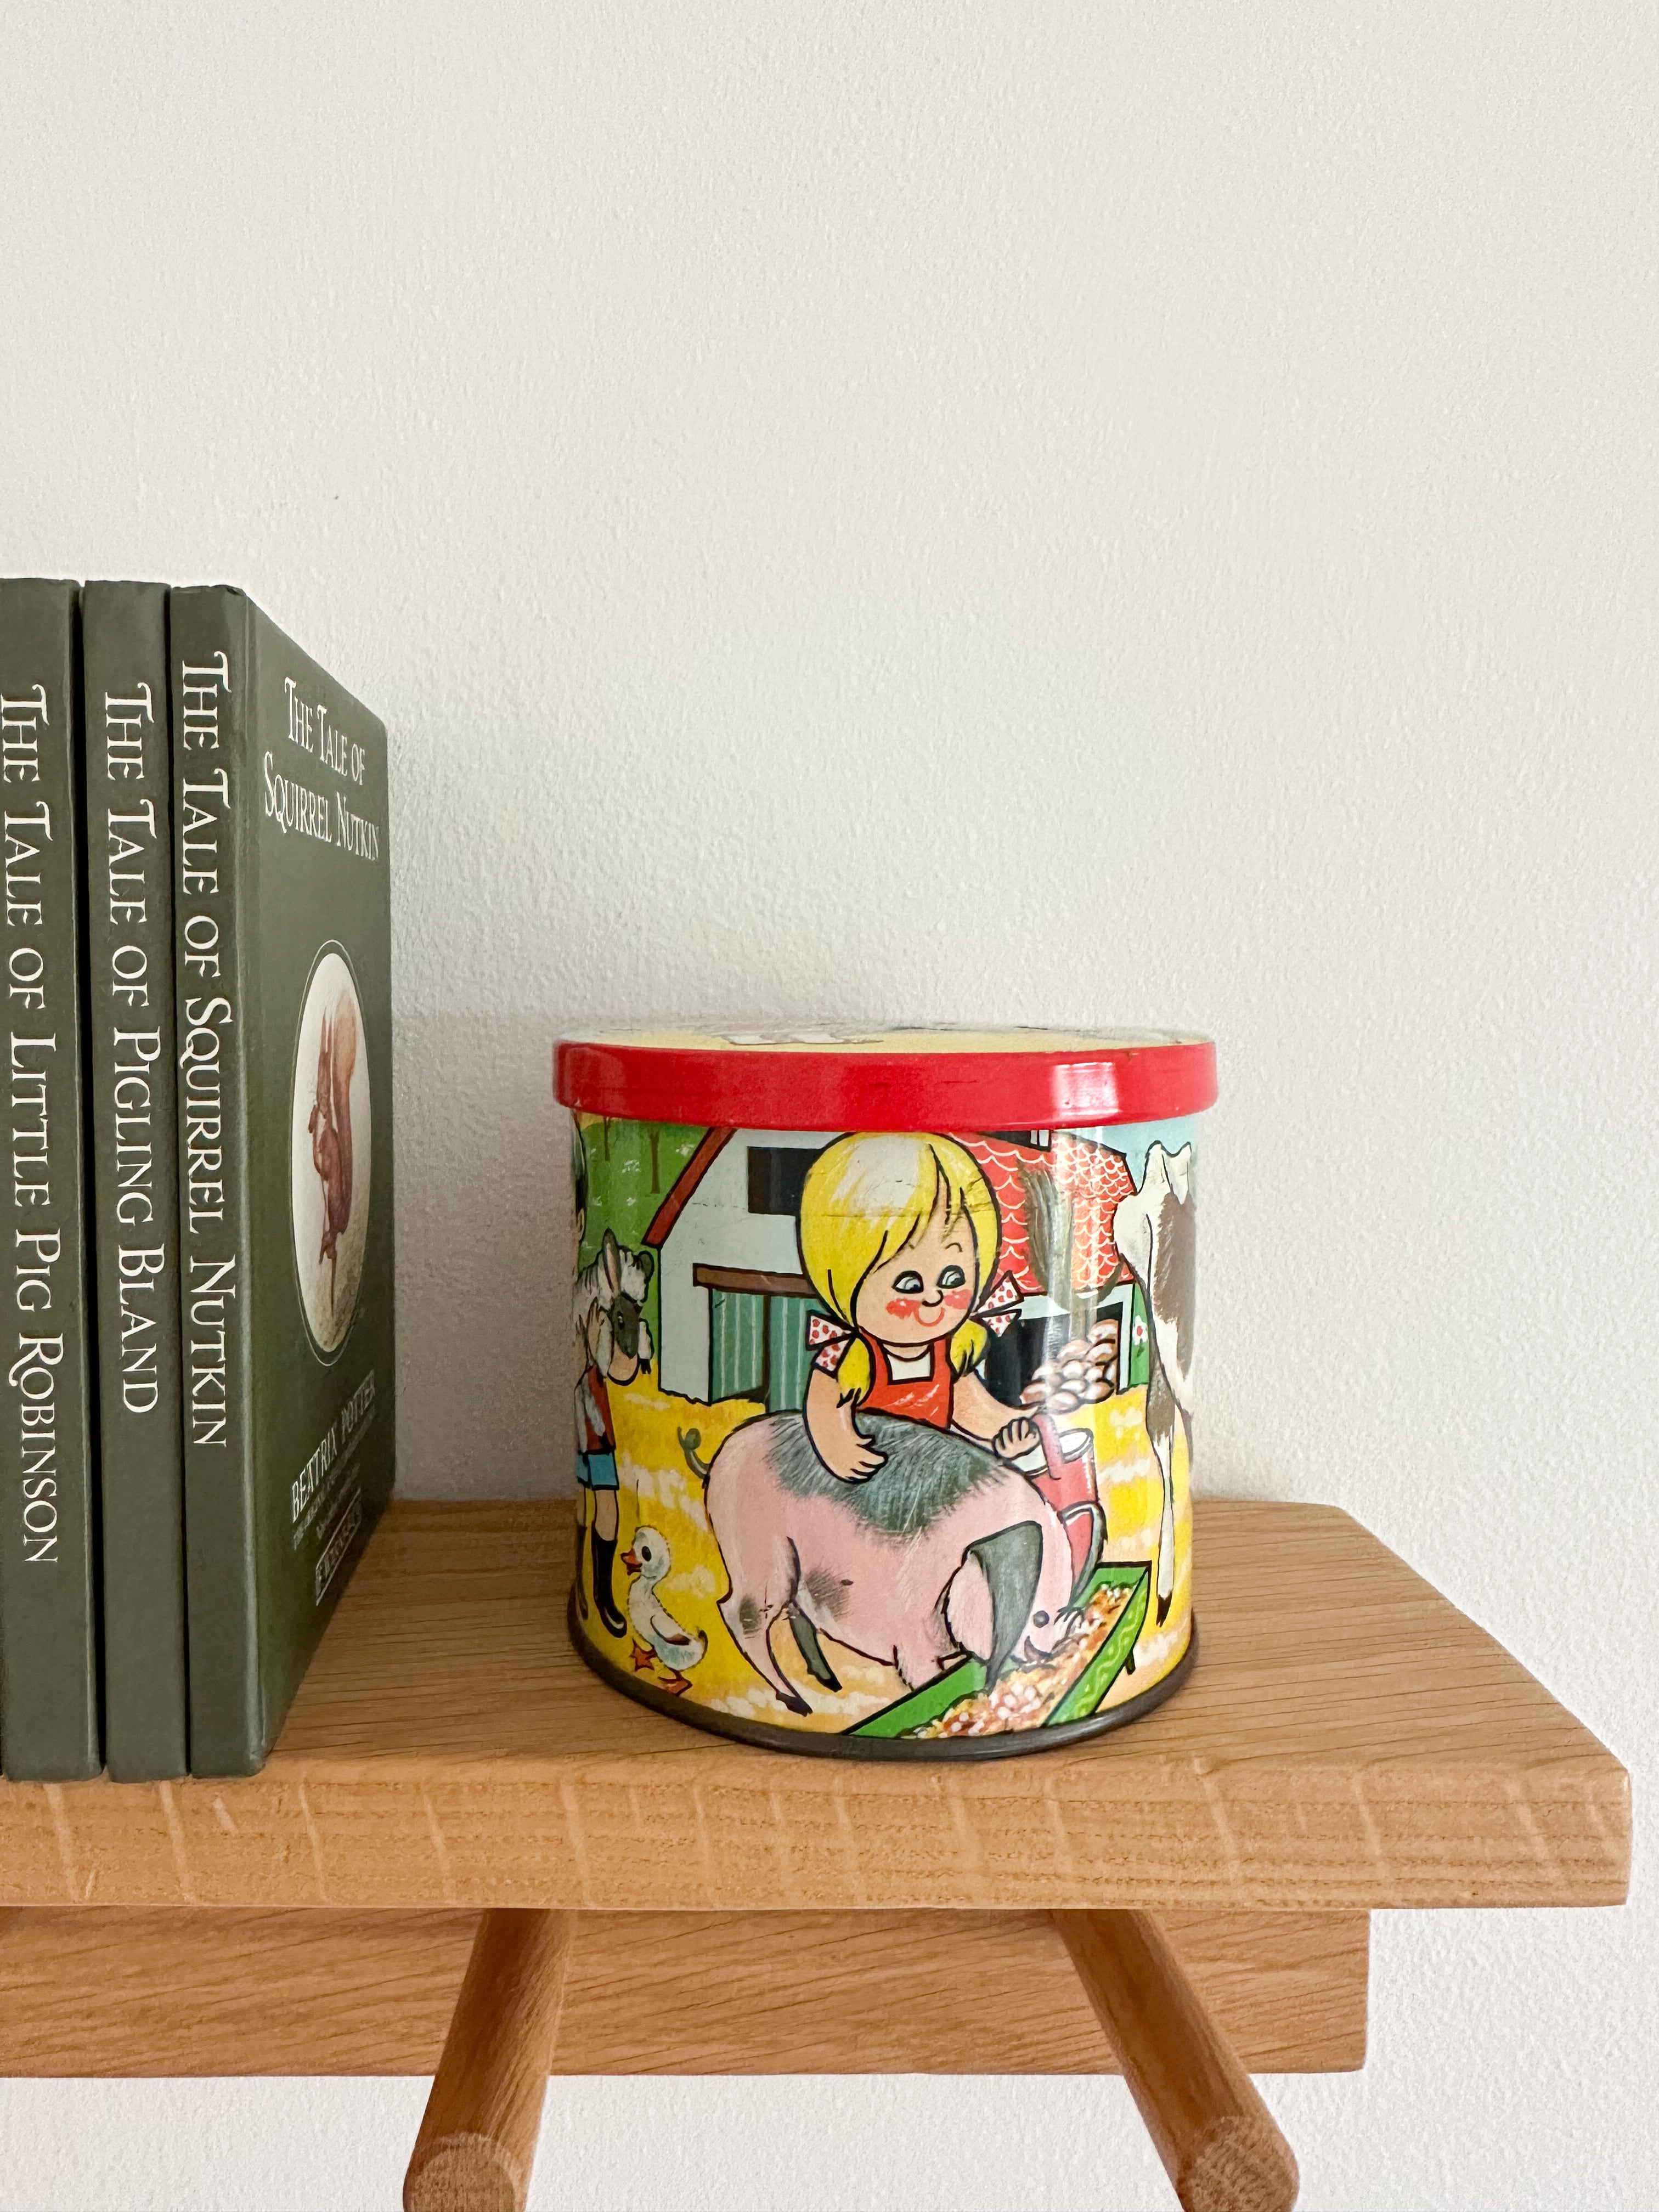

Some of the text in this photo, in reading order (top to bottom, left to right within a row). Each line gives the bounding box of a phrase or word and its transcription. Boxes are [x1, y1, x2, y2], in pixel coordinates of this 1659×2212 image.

[264, 751, 379, 861] SQUIRREL NUTKIN
[284, 676, 366, 786] THE TALE OF
[1, 684, 64, 1563] THE TALE OF LITTLE PIG ROBINSON
[105, 682, 165, 1413] THE TALE OF PIGLING BLAND
[179, 651, 236, 1448] THE TALE OF SQUIRREL NUTKIN
[292, 1422, 338, 1523] BEATRIX
